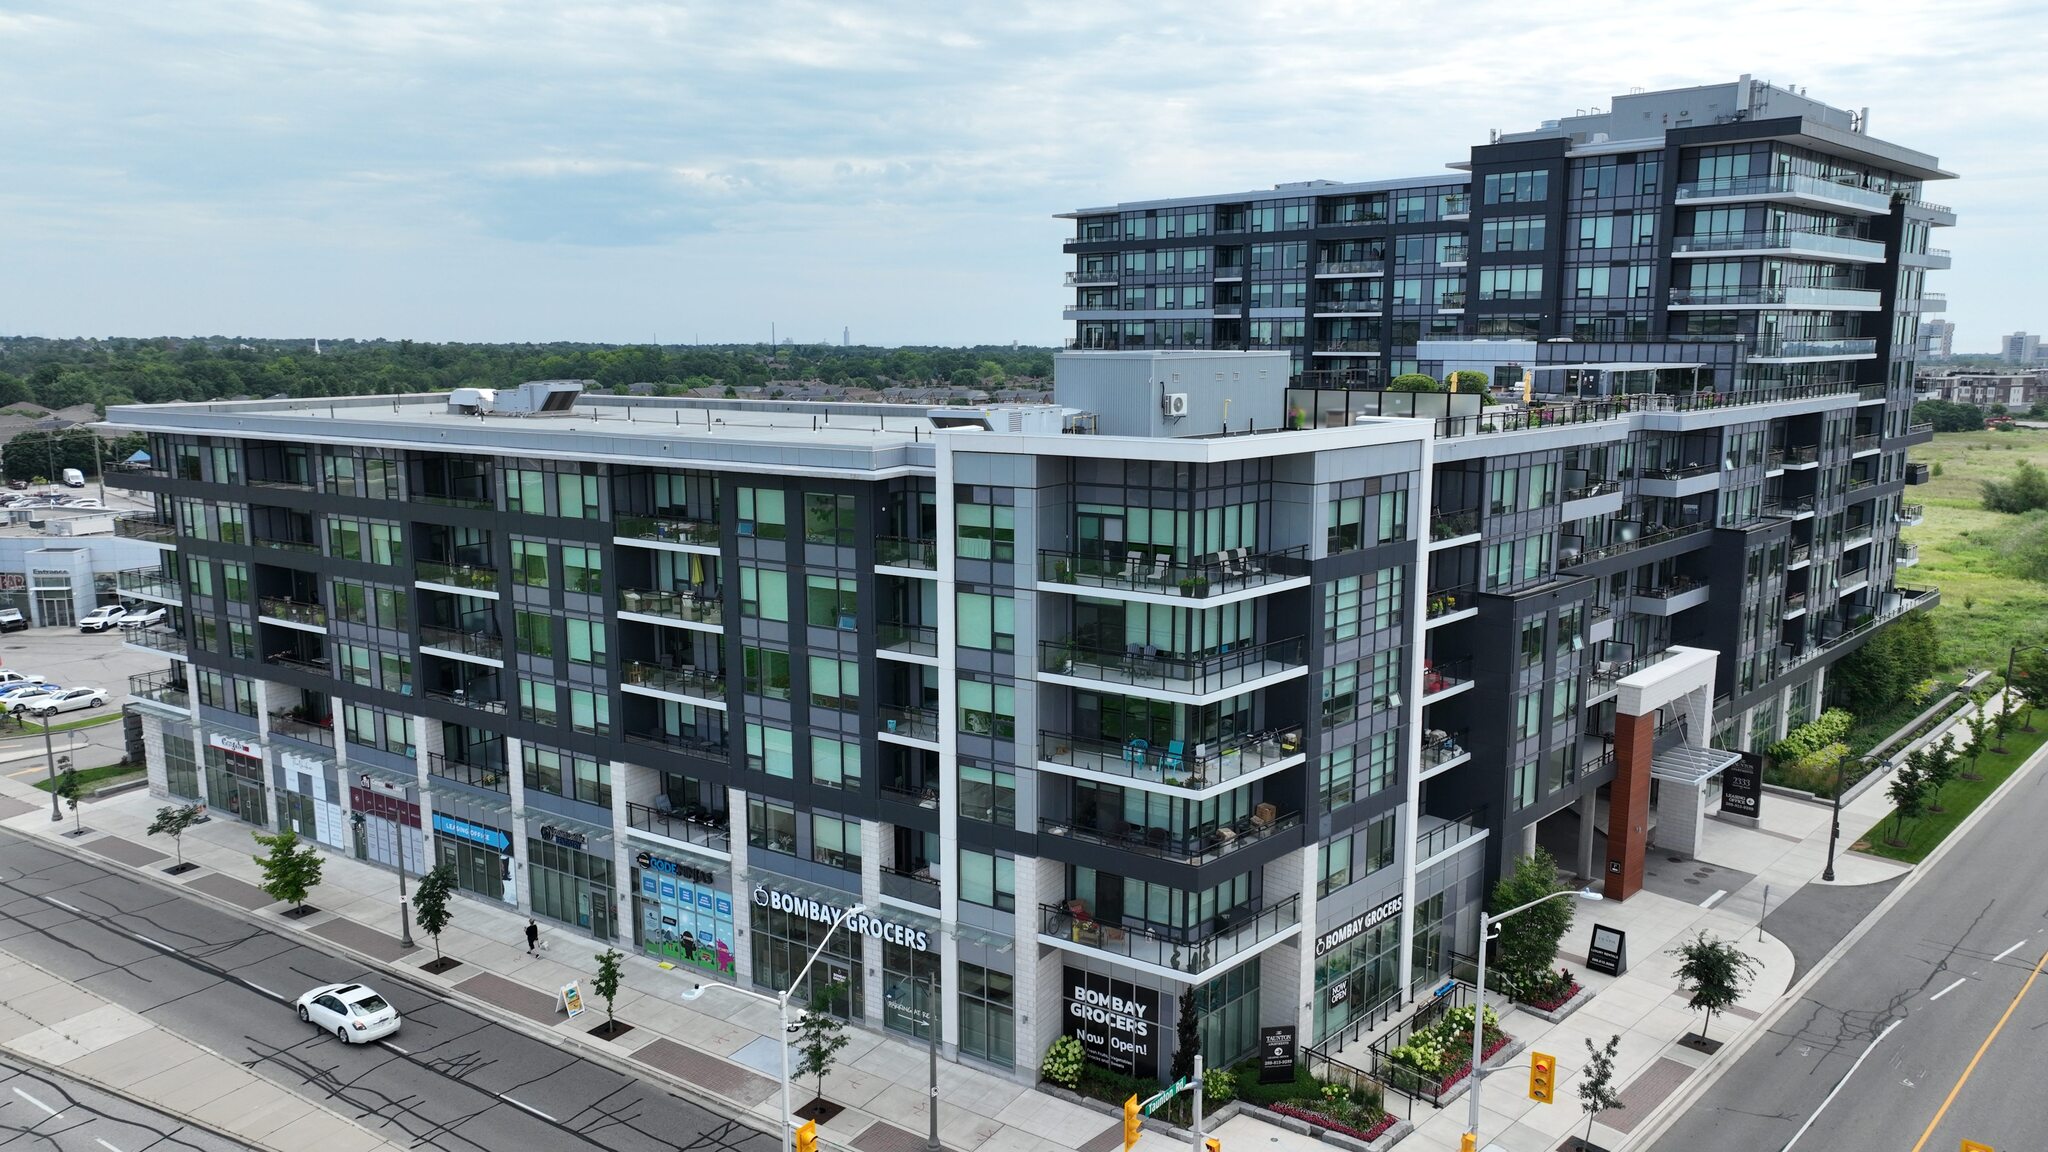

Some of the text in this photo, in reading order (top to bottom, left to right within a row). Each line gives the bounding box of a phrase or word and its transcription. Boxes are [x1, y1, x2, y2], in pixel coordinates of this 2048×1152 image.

[1732, 776, 1751, 787] 2333
[1725, 792, 1746, 800] LEASING
[1728, 797, 1746, 805] OFFICE
[445, 822, 490, 841] LEASING OFFICE
[650, 857, 677, 874] CODE
[677, 863, 713, 884] NINJAS
[771, 890, 927, 951] BOMBAY GROCERS
[1326, 896, 1402, 950] BOMBAY GROCERS
[1331, 989, 1347, 1003] OPEN
[1332, 980, 1347, 994] NOW
[1074, 986, 1147, 1018] BOMBAY
[1070, 1002, 1148, 1036] GROCERS
[1076, 1028, 1147, 1055] Now Open!
[1266, 1034, 1292, 1042] TAUNTON
[1149, 1077, 1184, 1115] Taunton Rd
